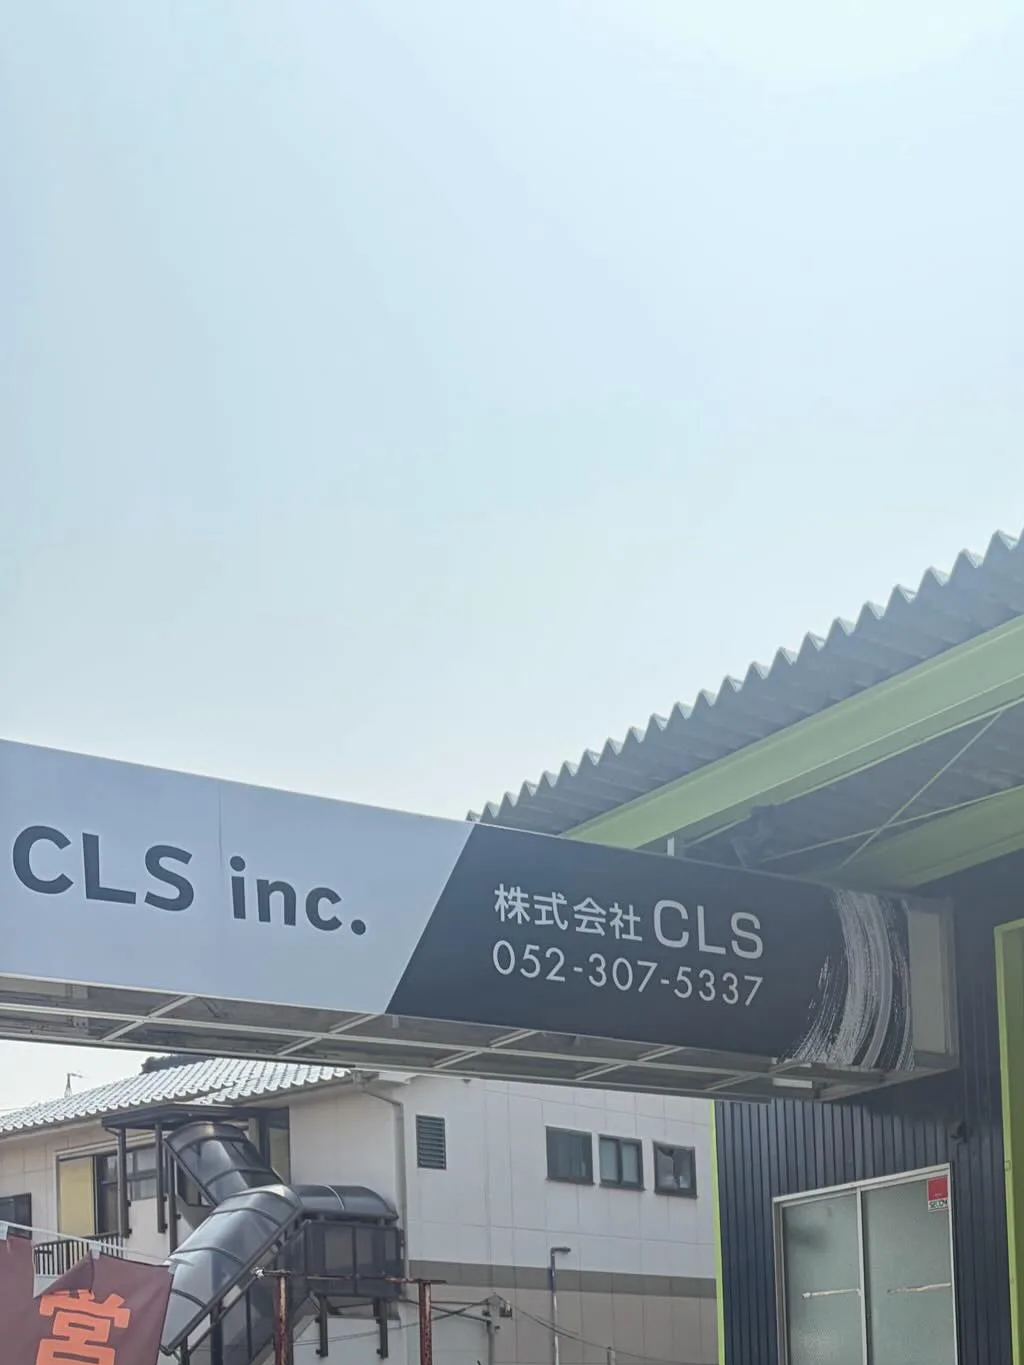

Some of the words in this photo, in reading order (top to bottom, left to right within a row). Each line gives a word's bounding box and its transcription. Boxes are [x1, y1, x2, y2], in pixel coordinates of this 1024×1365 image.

[12, 825, 194, 911] CLS
[229, 855, 366, 935] inc.
[492, 940, 764, 1006] 052-307-5337
